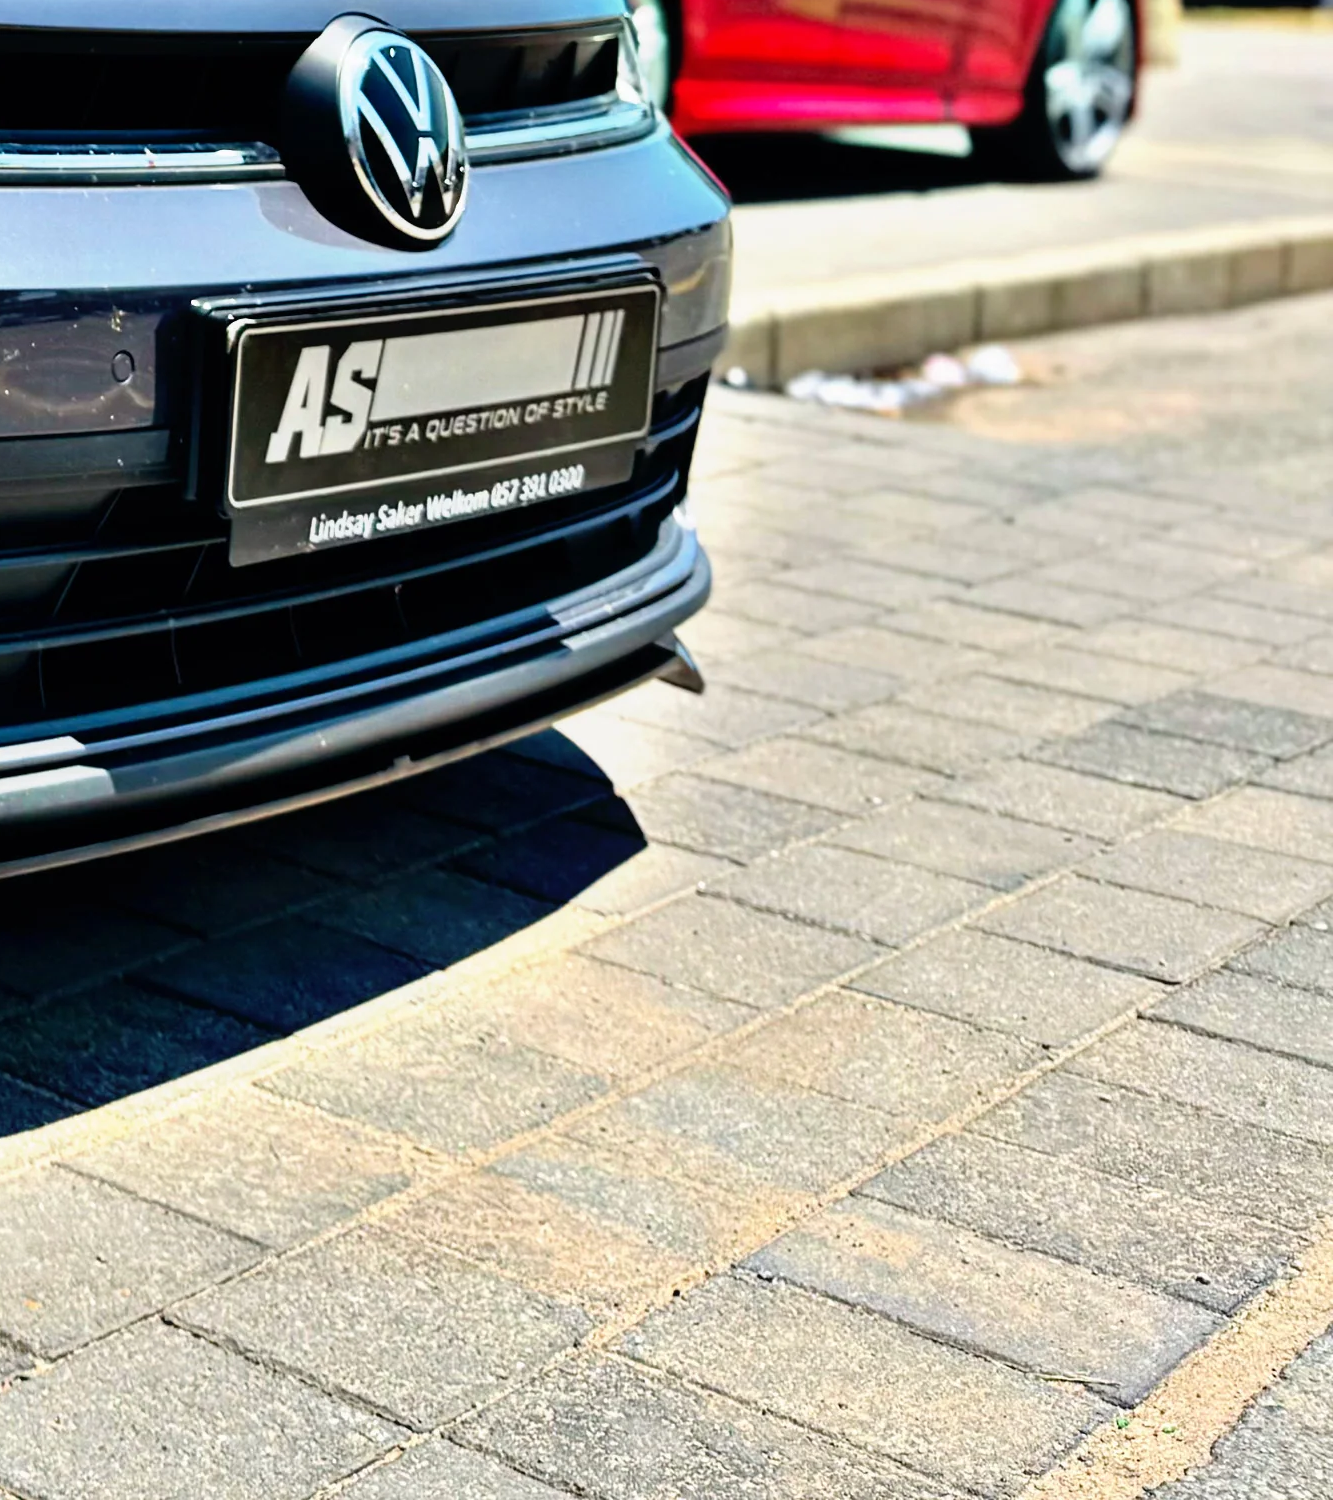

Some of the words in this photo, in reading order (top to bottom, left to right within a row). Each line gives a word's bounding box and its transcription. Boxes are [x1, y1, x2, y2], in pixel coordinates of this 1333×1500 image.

[265, 338, 384, 464] AS
[363, 423, 404, 449] IT'S
[405, 422, 420, 443] A
[425, 405, 521, 443] QUESTION
[524, 401, 553, 424] OF
[552, 390, 610, 419] STYLE
[309, 509, 376, 543] Lindsay
[376, 499, 424, 531] Saker
[426, 488, 490, 521] Welkom
[491, 477, 521, 508] 057
